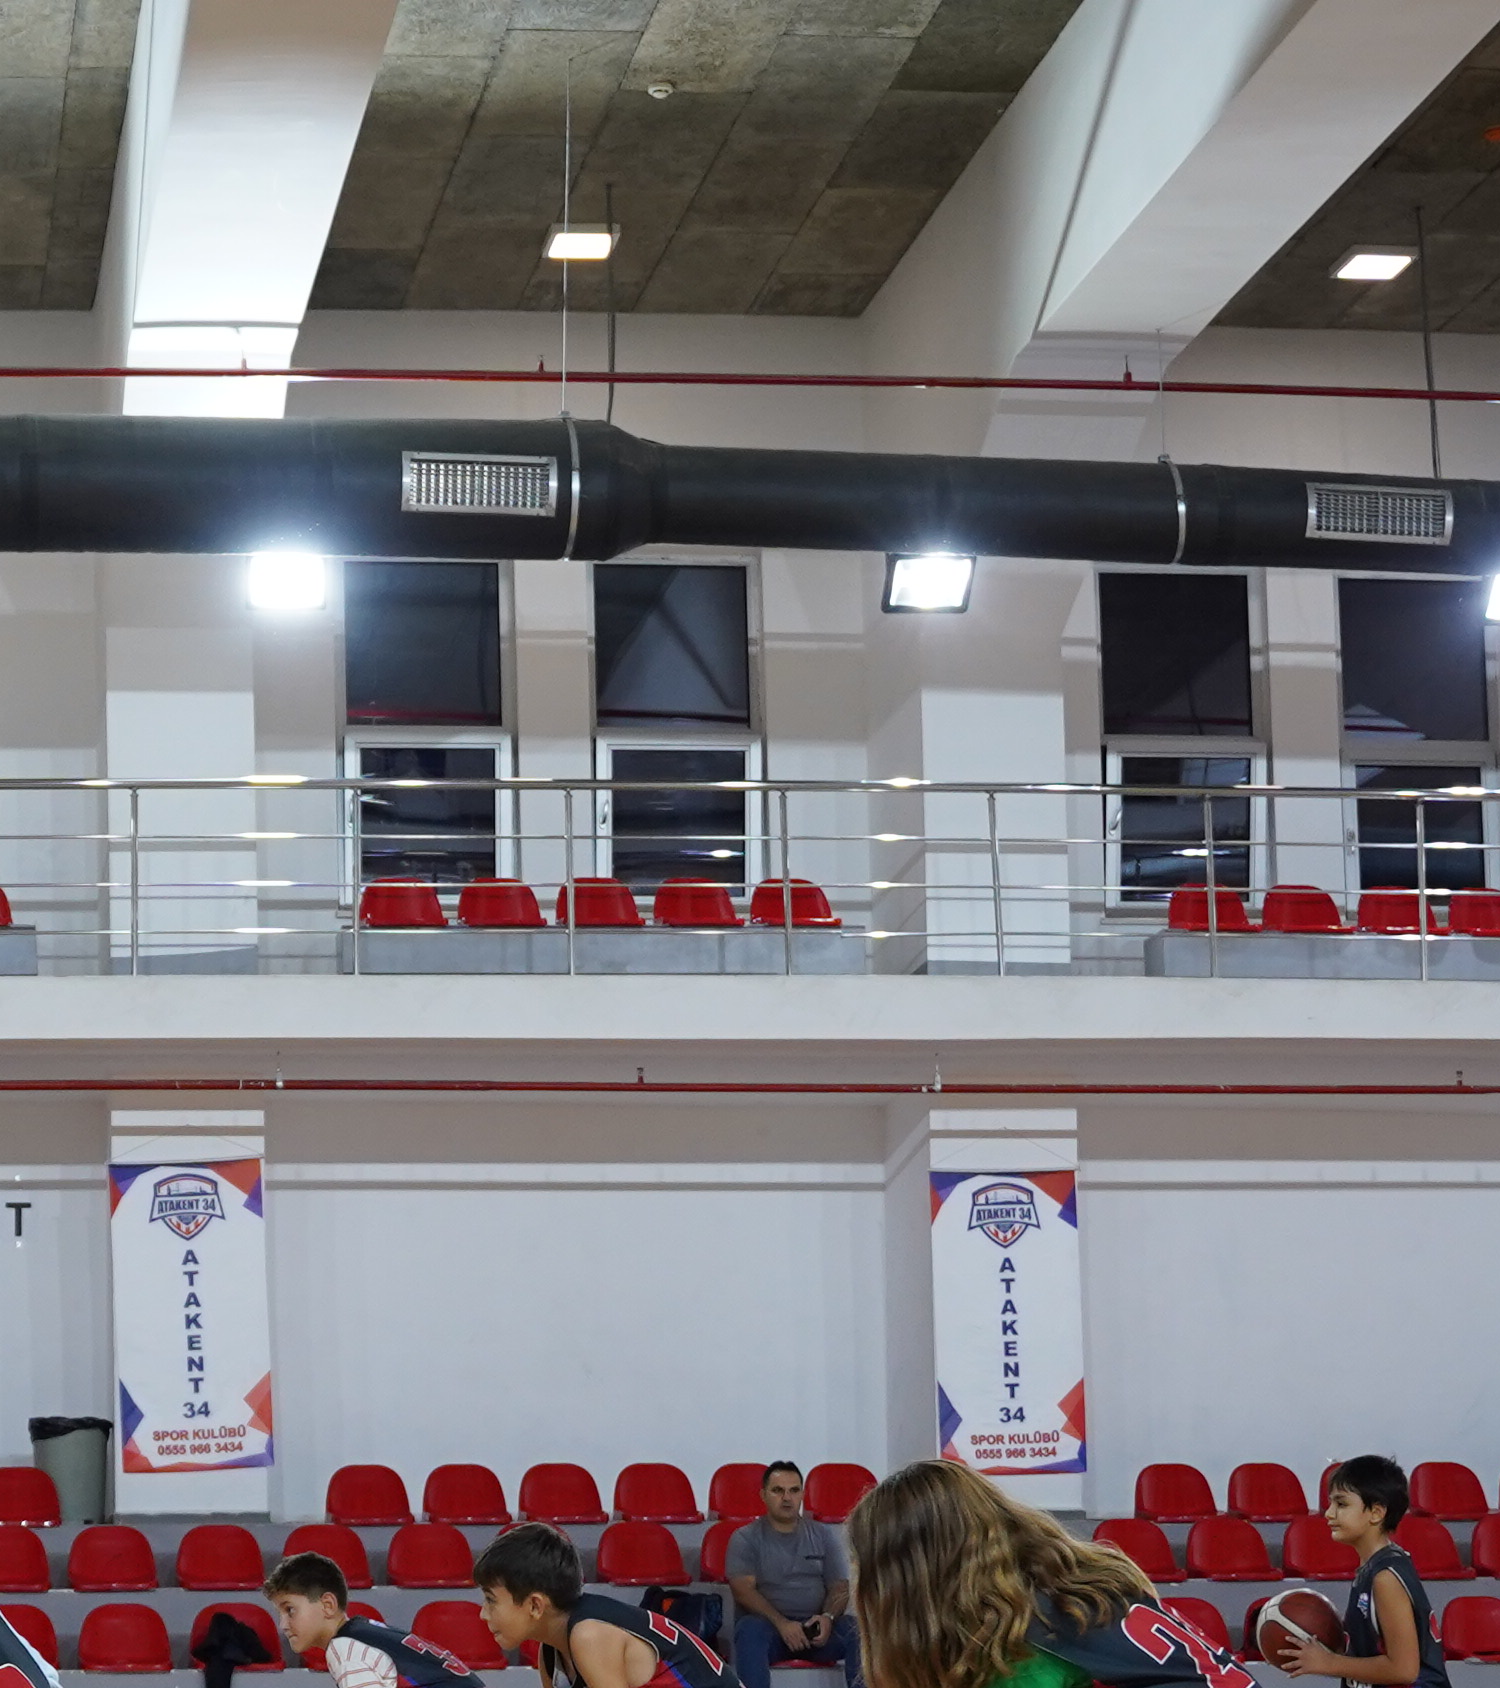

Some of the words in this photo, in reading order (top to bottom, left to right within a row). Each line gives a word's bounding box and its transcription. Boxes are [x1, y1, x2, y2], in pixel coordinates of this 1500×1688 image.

[157, 1198, 200, 1214] ATAKENT
[976, 1207, 1017, 1223] ATAKENT
[181, 1249, 205, 1394] ATAKENT
[999, 1257, 1020, 1399] ATAKENT
[183, 1402, 211, 1419] 34
[999, 1407, 1026, 1424] 34
[152, 1429, 189, 1441] SPOR
[192, 1425, 246, 1439] KULÜBÜ
[970, 1434, 1005, 1446] SPOR
[1009, 1431, 1060, 1445] KULÜBÜ
[214, 1441, 243, 1453] 3434
[1029, 1446, 1057, 1457] 3434
